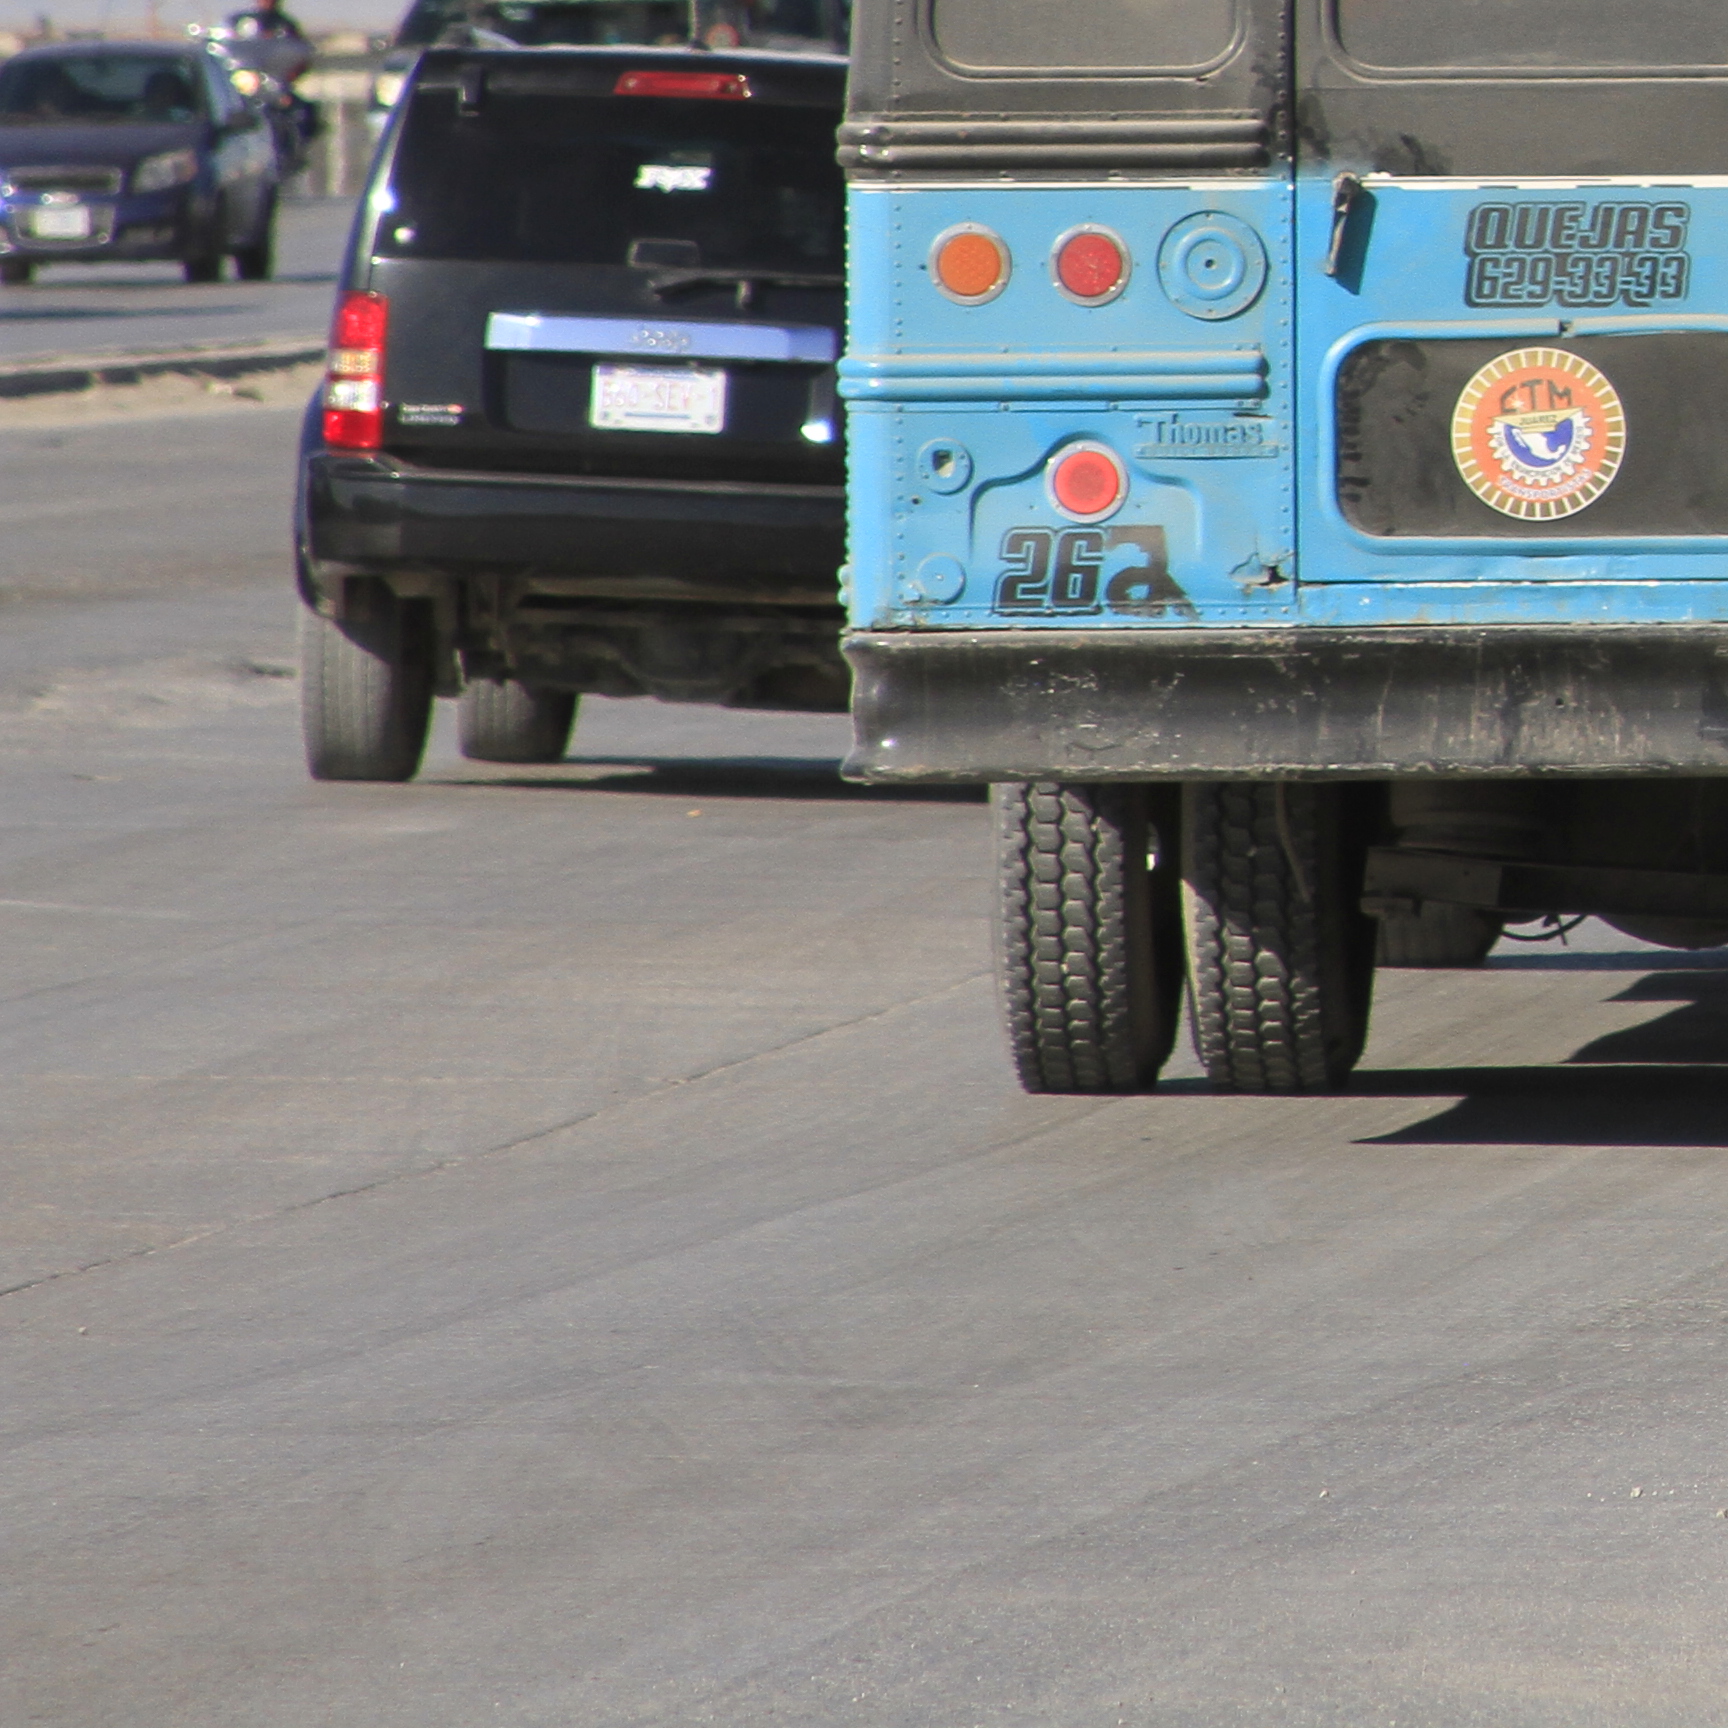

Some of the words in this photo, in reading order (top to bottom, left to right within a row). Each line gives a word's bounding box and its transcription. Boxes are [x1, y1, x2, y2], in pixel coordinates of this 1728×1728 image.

[1466, 201, 1690, 255] QUEJAS
[1466, 253, 1691, 307] 629-33-33
[1500, 378, 1573, 413] CTM
[1136, 413, 1264, 445] Thomas
